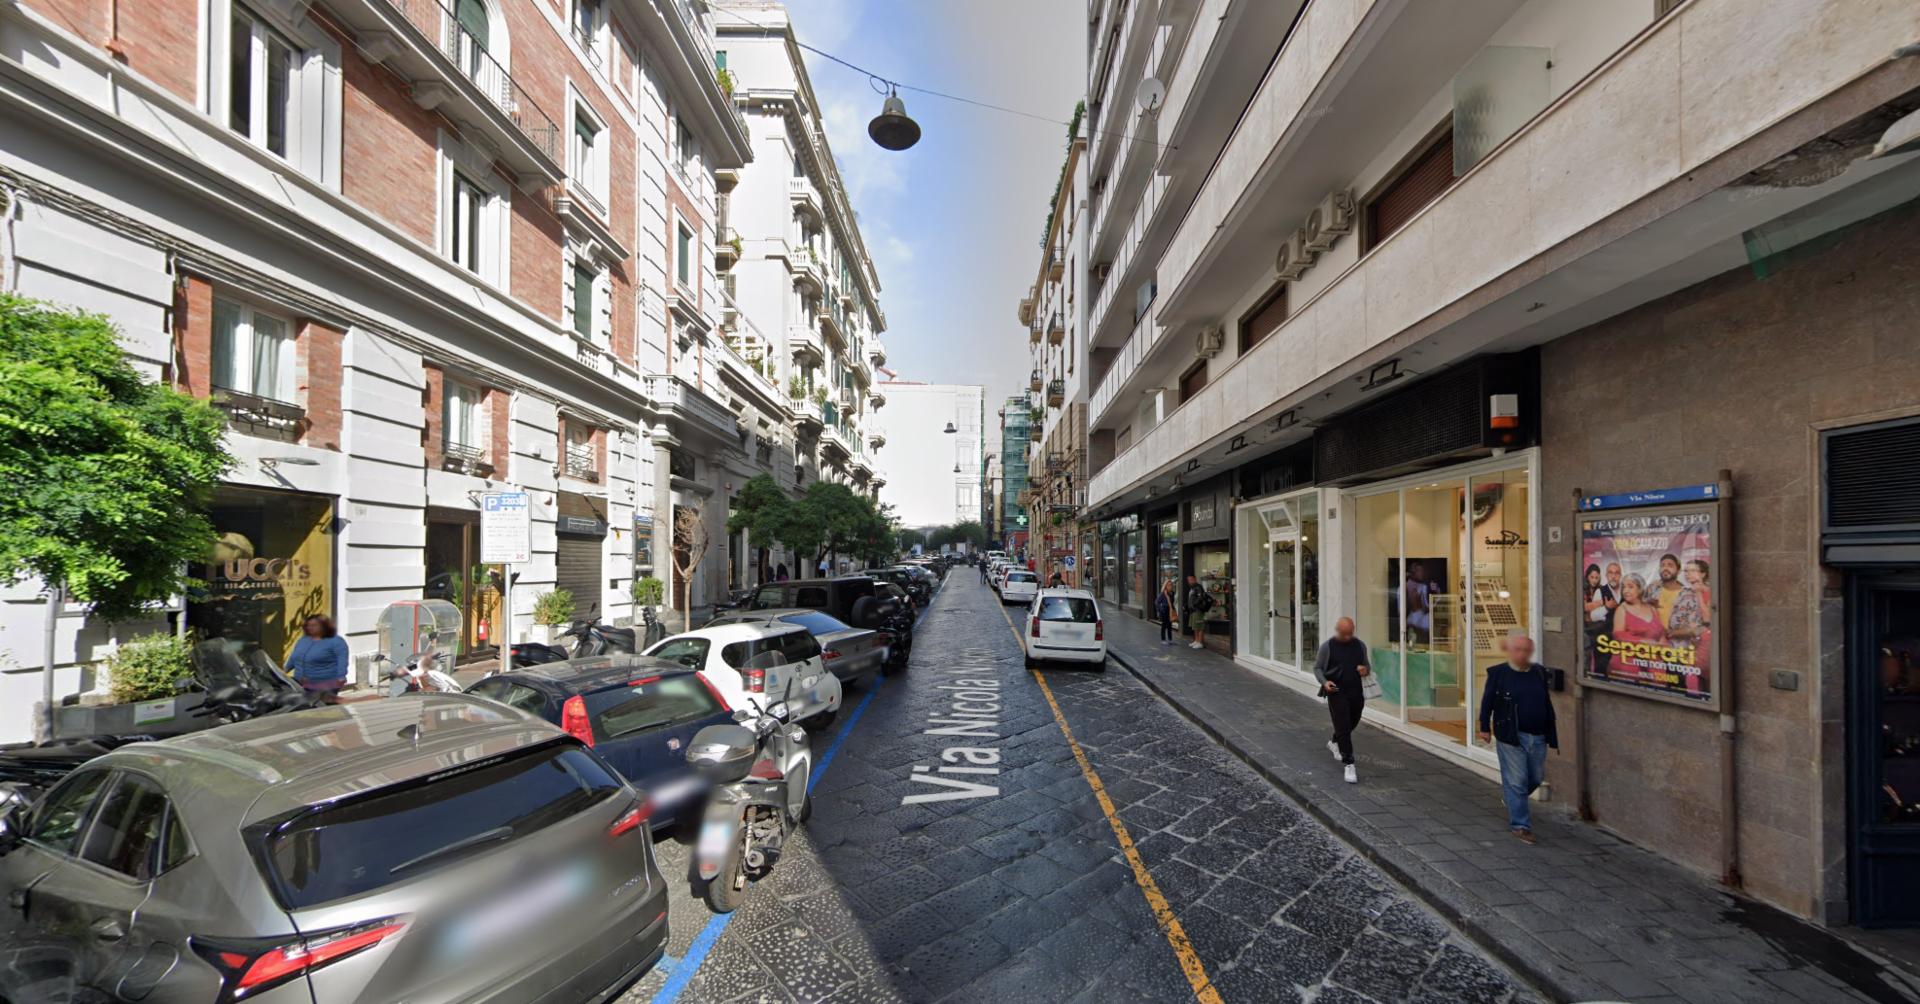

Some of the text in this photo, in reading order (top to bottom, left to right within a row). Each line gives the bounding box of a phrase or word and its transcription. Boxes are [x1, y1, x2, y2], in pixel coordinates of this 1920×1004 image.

[488, 498, 498, 510] P
[1592, 518, 1637, 531] TEATRO
[1596, 634, 1696, 665] Separati
